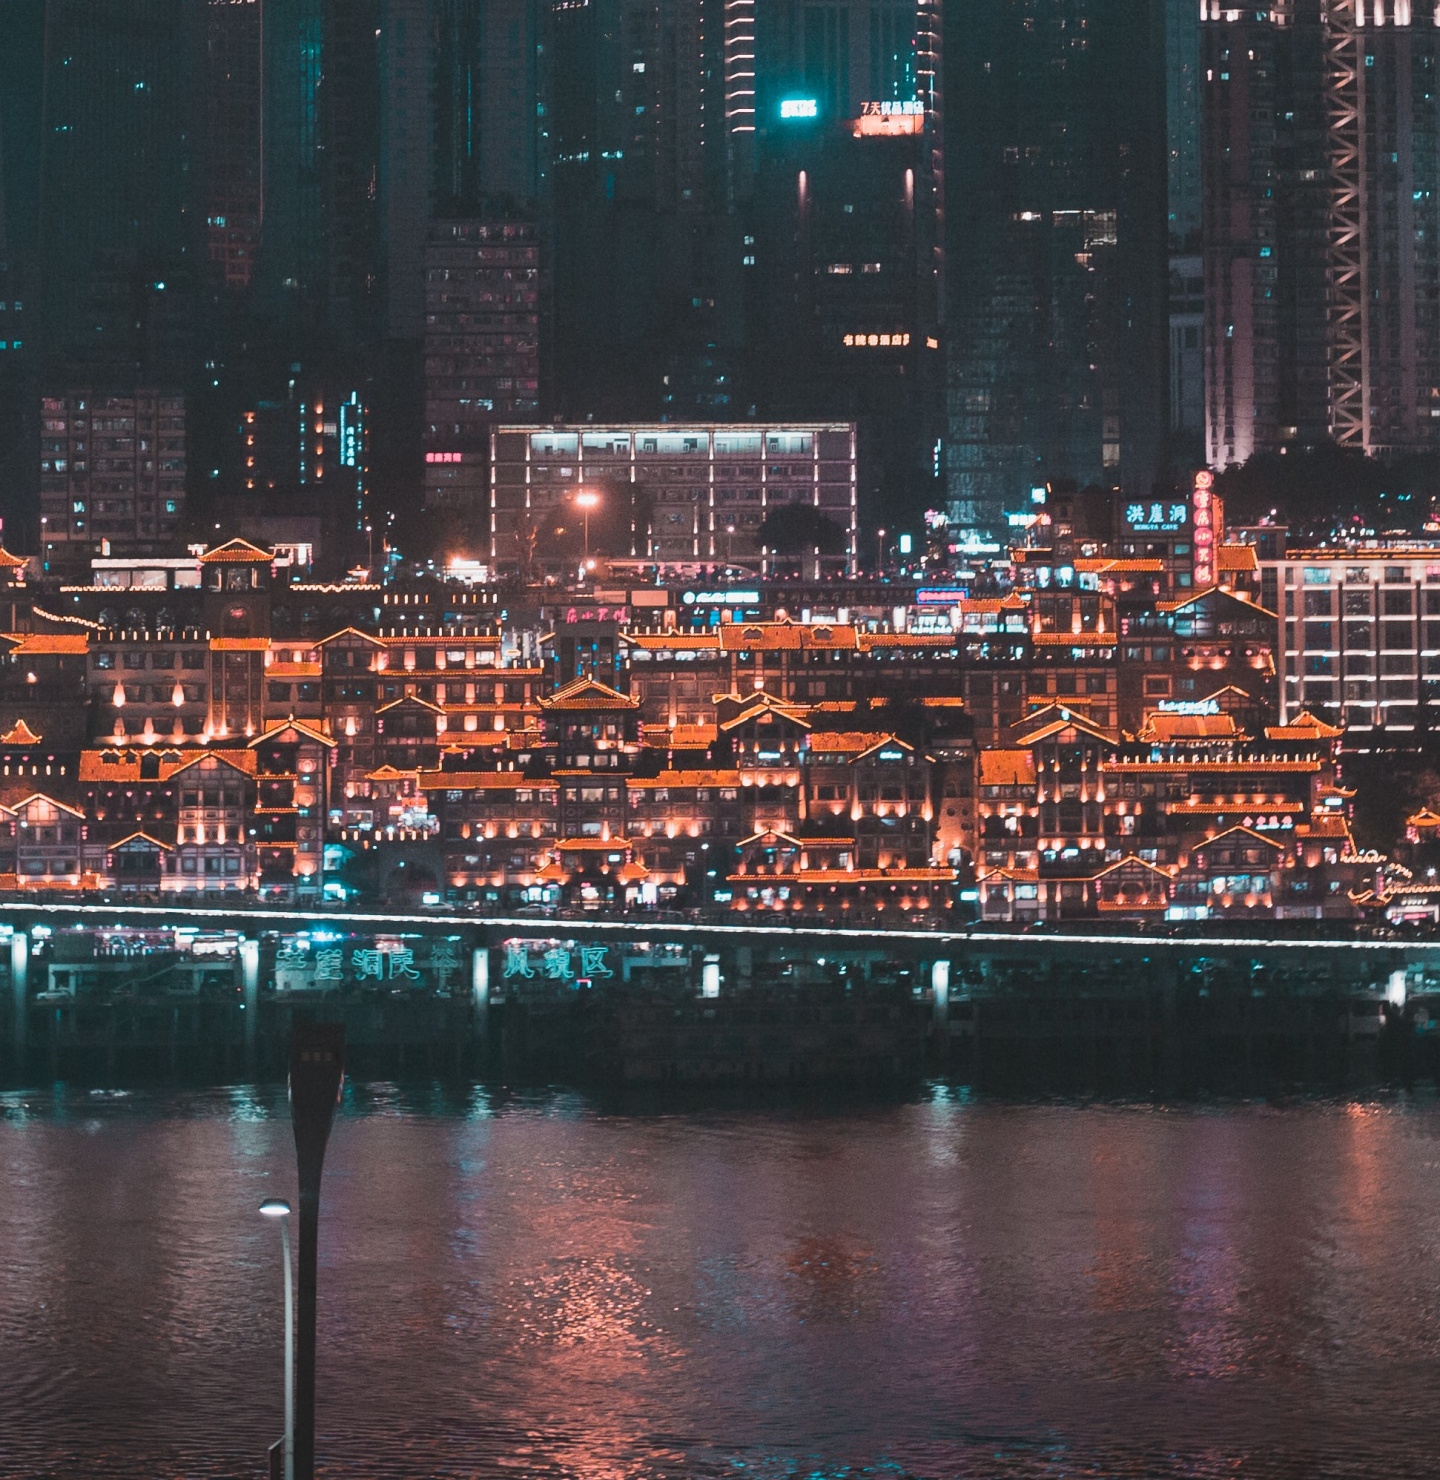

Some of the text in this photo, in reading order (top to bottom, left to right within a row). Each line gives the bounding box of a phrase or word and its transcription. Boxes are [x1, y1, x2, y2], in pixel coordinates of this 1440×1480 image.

[861, 100, 924, 115] 7天优品酒店
[1126, 503, 1187, 524] 洪崖洞
